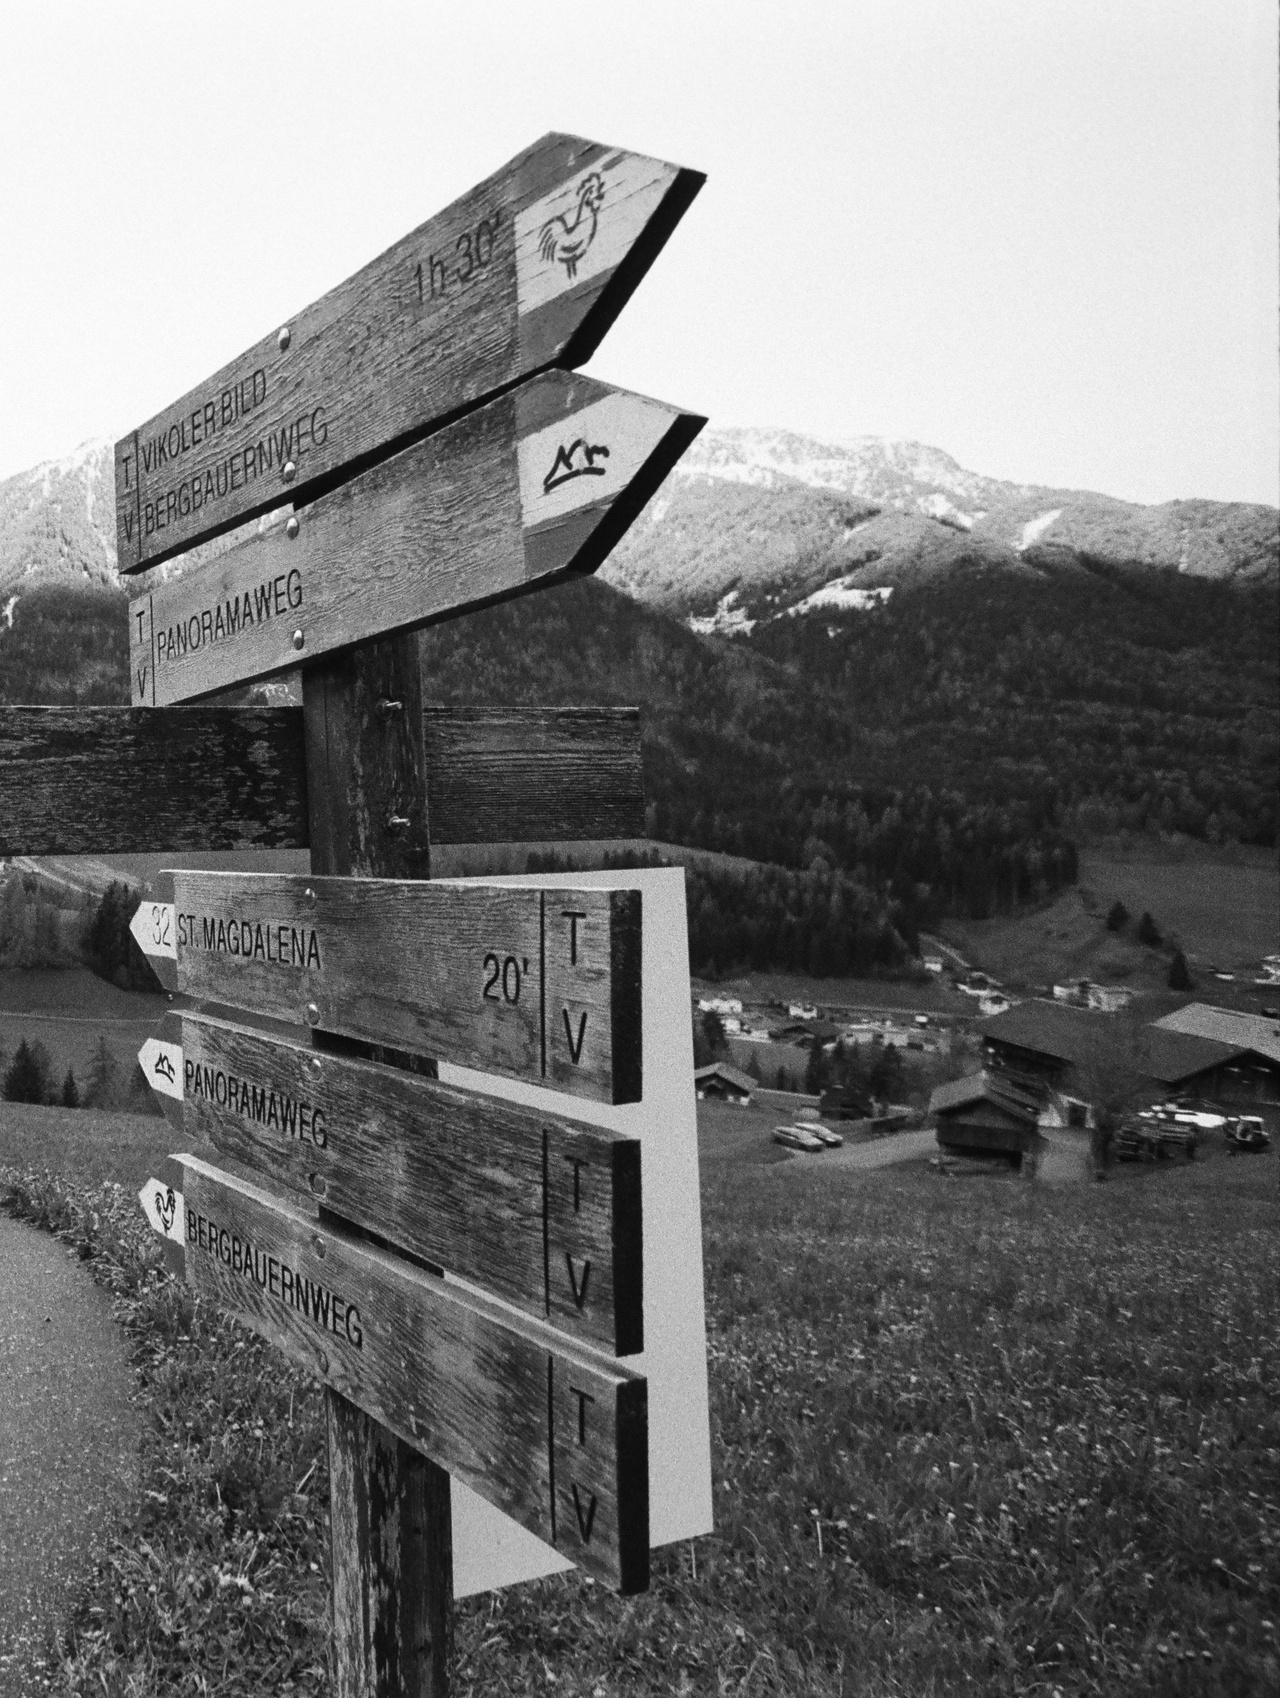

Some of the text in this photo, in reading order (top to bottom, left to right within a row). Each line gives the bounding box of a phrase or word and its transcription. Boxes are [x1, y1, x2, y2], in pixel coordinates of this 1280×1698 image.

[140, 367, 267, 475] VIKOLER BILD
[122, 456, 132, 488] T
[144, 406, 329, 537] BERGBAUERNWEG
[123, 511, 134, 544] V
[135, 610, 146, 644] T
[156, 568, 304, 664] PANORAMAWEG
[136, 666, 147, 699] V
[151, 905, 171, 947] 32
[178, 913, 322, 970] ST. MAGDALENA
[561, 911, 587, 966] T
[562, 1008, 588, 1066] V
[185, 1059, 328, 1150] PANORAMAWEG
[564, 1154, 591, 1213] T
[187, 1209, 364, 1349] BERGBAUERNWEG
[566, 1252, 592, 1311] V
[569, 1386, 596, 1447] T
[571, 1483, 598, 1545] V
